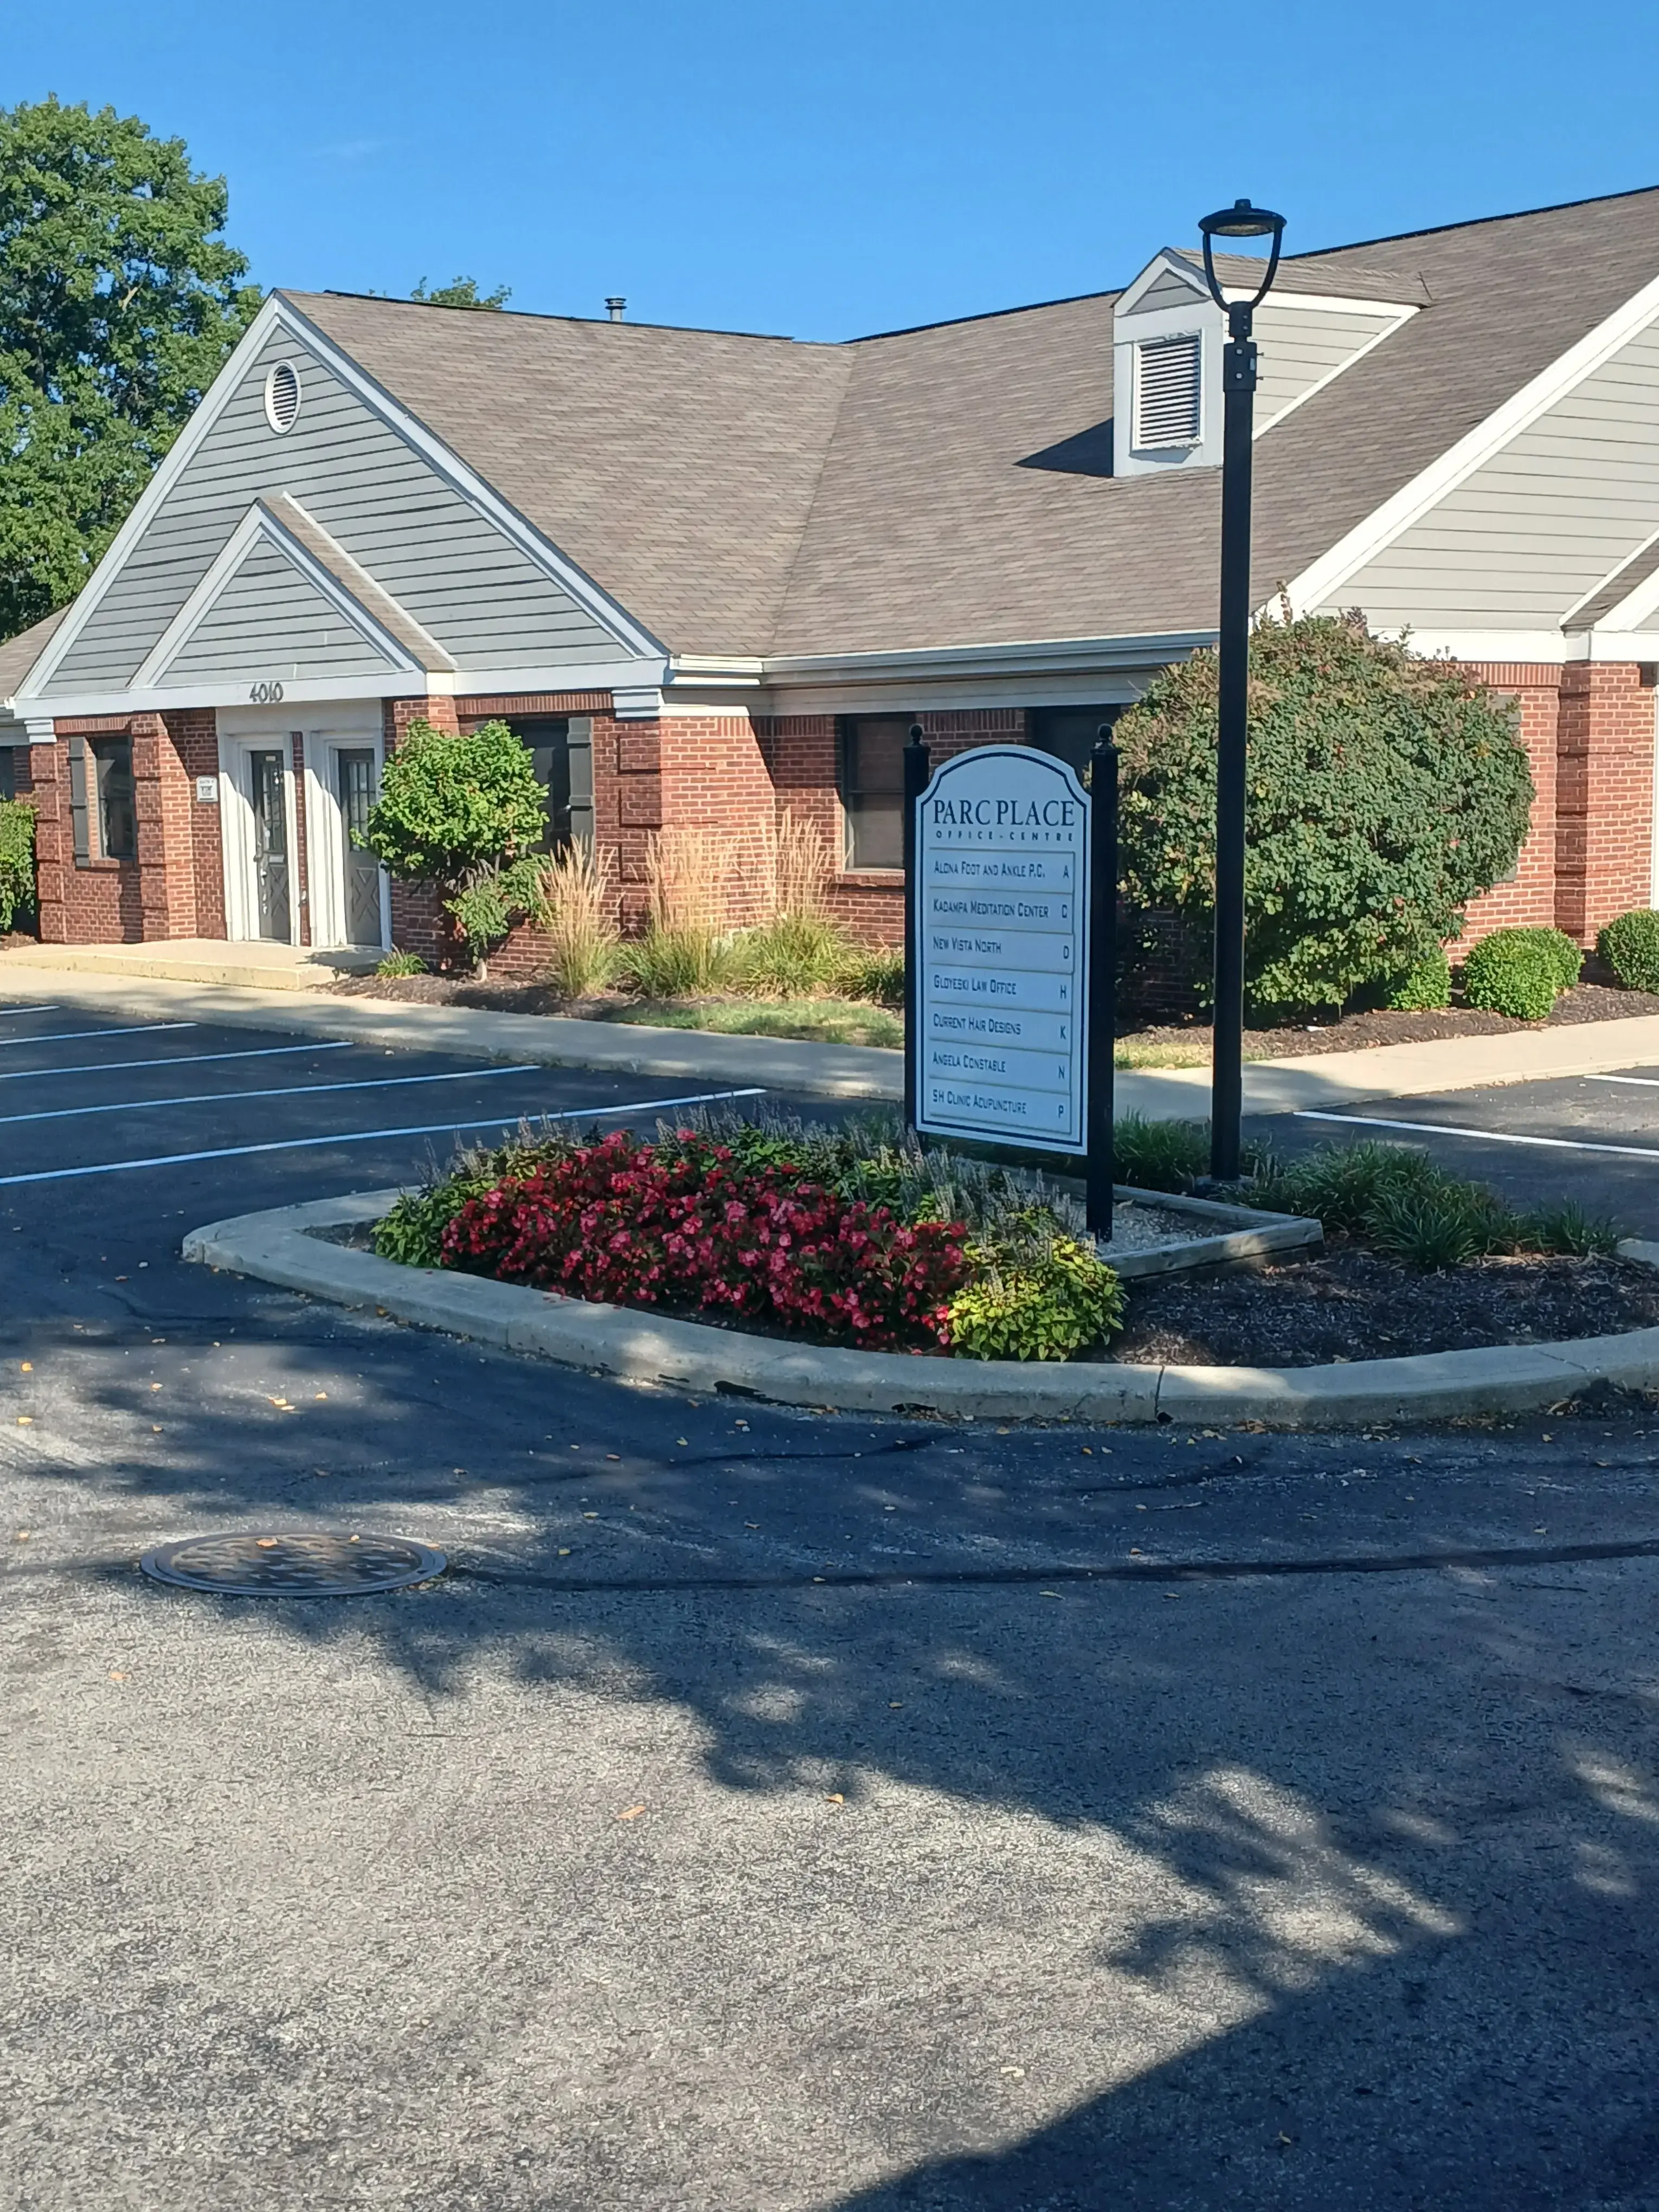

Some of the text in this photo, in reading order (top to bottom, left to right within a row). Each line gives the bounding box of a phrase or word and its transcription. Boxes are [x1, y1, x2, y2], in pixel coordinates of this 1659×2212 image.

[248, 681, 284, 703] 4010
[933, 799, 1075, 827] PARC PLACE
[936, 830, 1072, 842] OFFICE CENTRE
[961, 860, 981, 876] FOOT
[982, 864, 999, 876] AND
[1001, 863, 1026, 877] ANKLE
[1028, 863, 1045, 878] P.C.
[1063, 865, 1070, 879] A
[933, 898, 1068, 919] KADAMPA MEDITATION CENTER C
[933, 936, 1070, 960] NEW VISTA NORTH D
[972, 978, 987, 992] LAW
[990, 979, 1017, 995] OFFICE
[1060, 985, 1067, 999] H
[933, 1013, 1066, 1040] CURRENT HAIR DESIGNS K
[933, 1051, 1065, 1079] ANGELA CONSTABLE N
[933, 1089, 1064, 1118] SH CLINIC ACUPUNCTURE P
